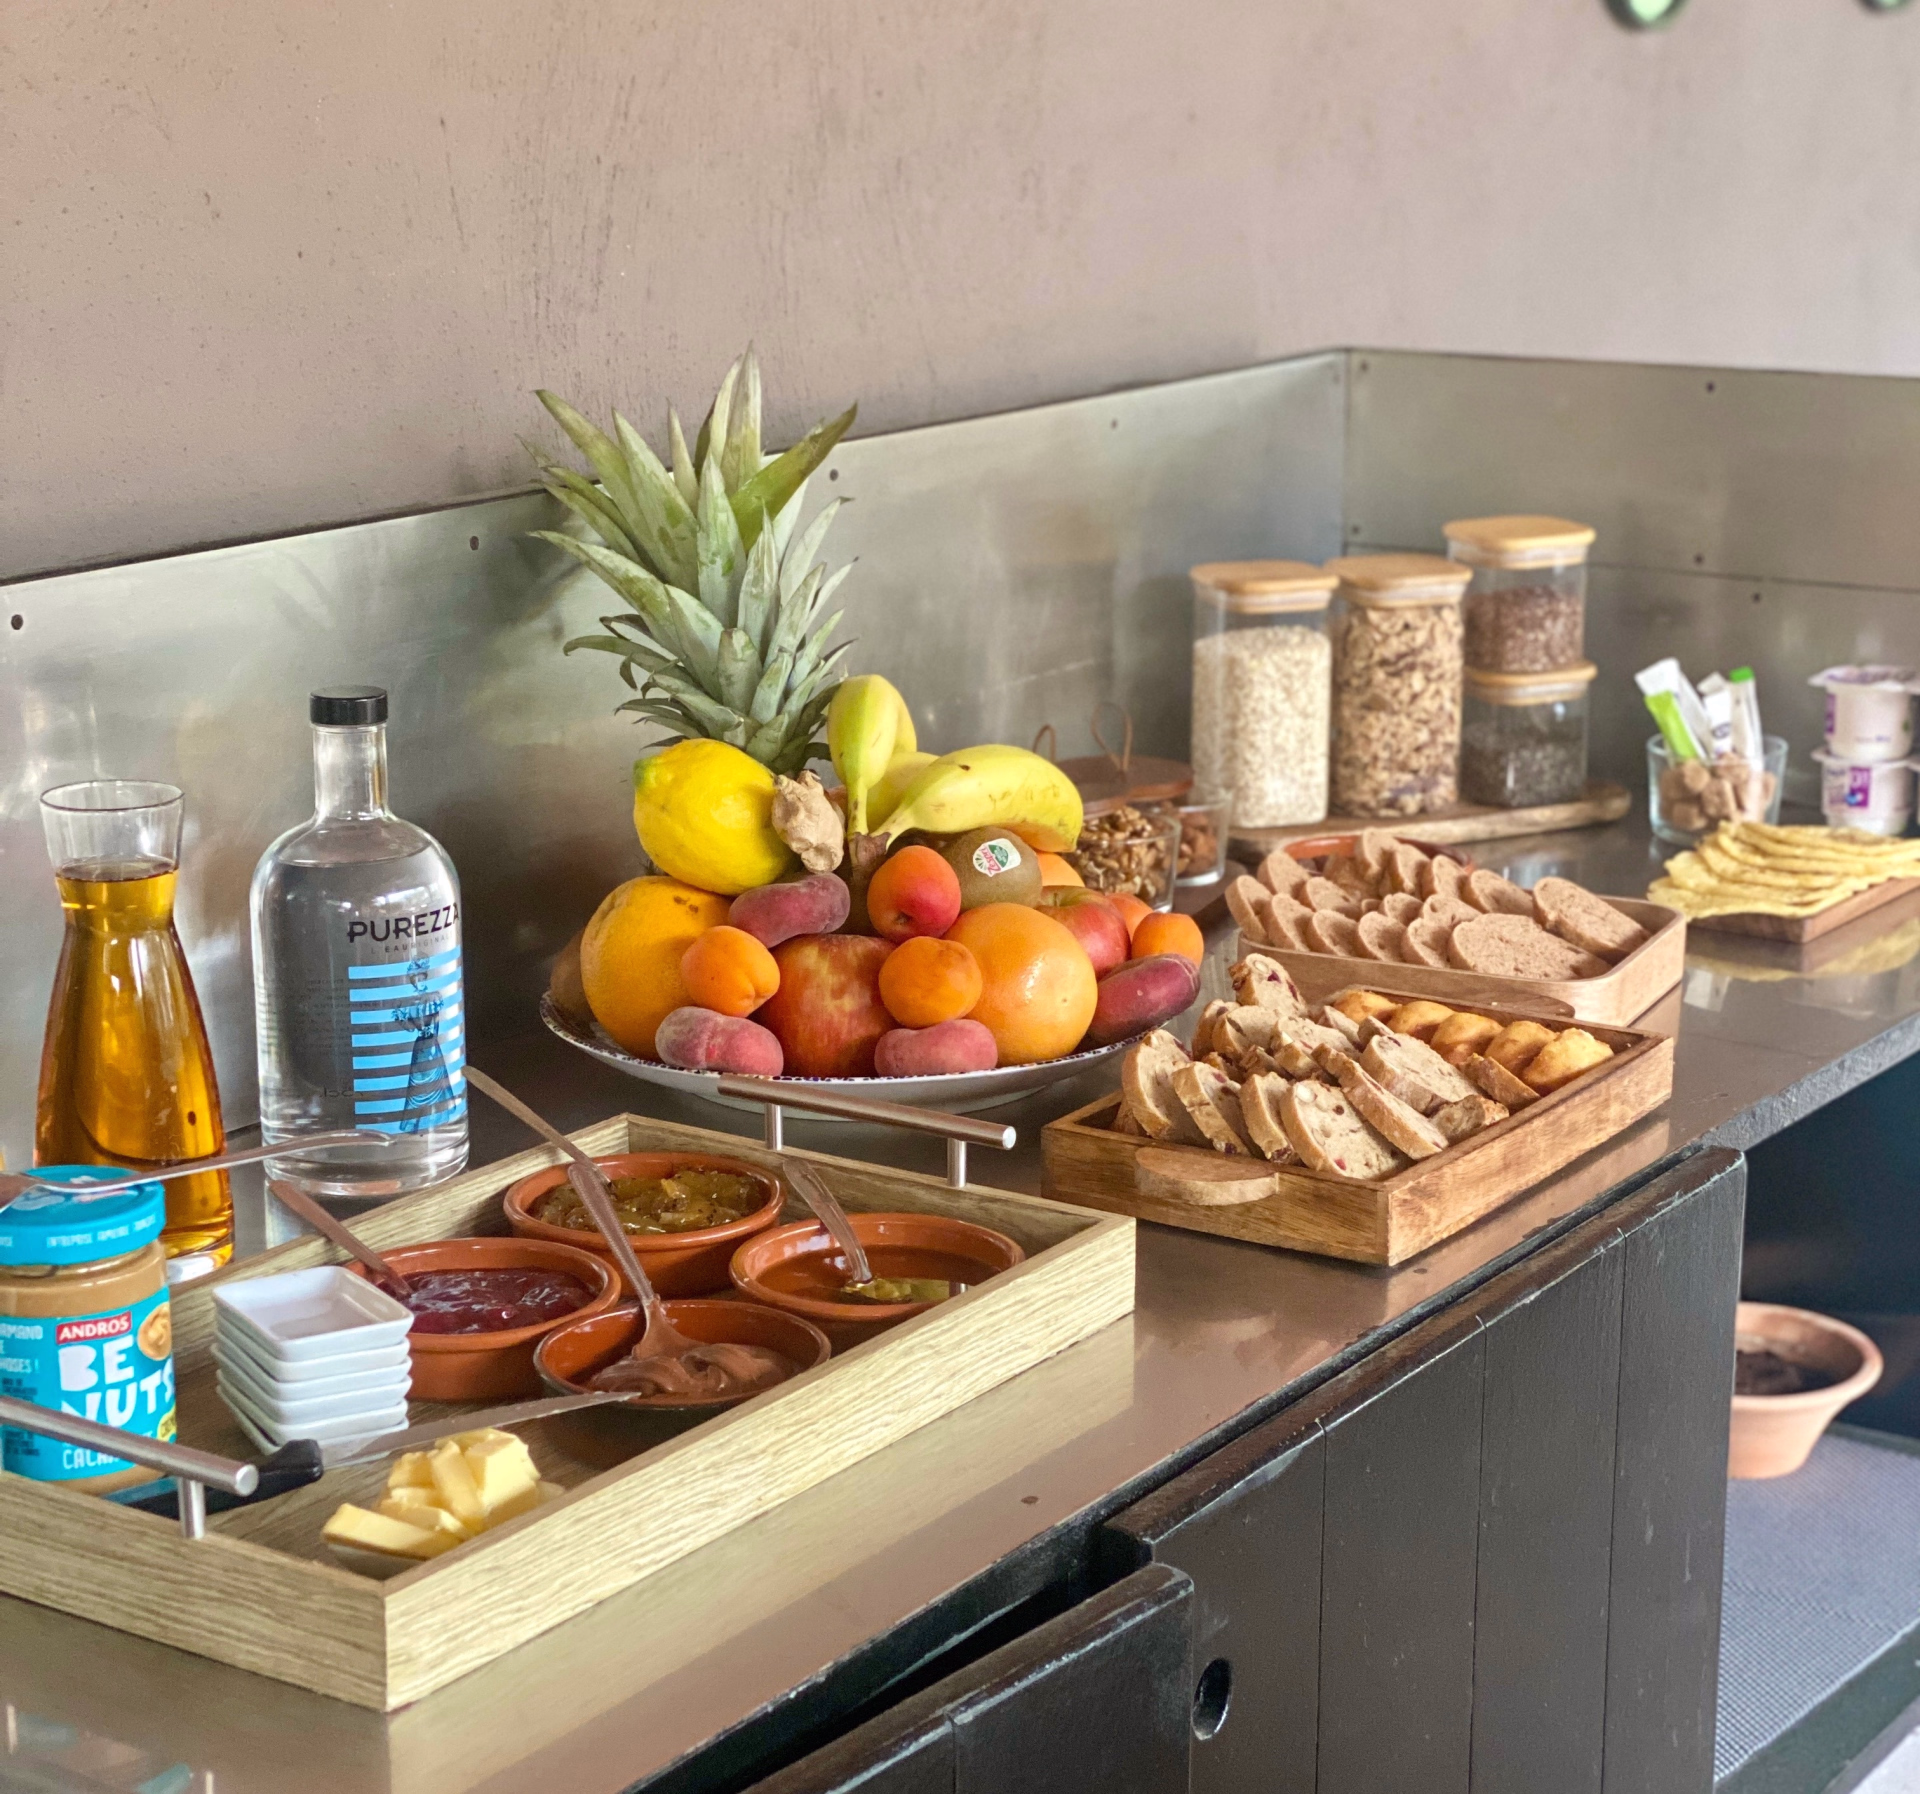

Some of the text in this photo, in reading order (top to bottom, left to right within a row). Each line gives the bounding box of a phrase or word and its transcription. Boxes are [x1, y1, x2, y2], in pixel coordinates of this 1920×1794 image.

[347, 903, 460, 943] PUREZZA
[59, 1315, 129, 1341] ANDROS
[58, 1334, 135, 1392] BE
